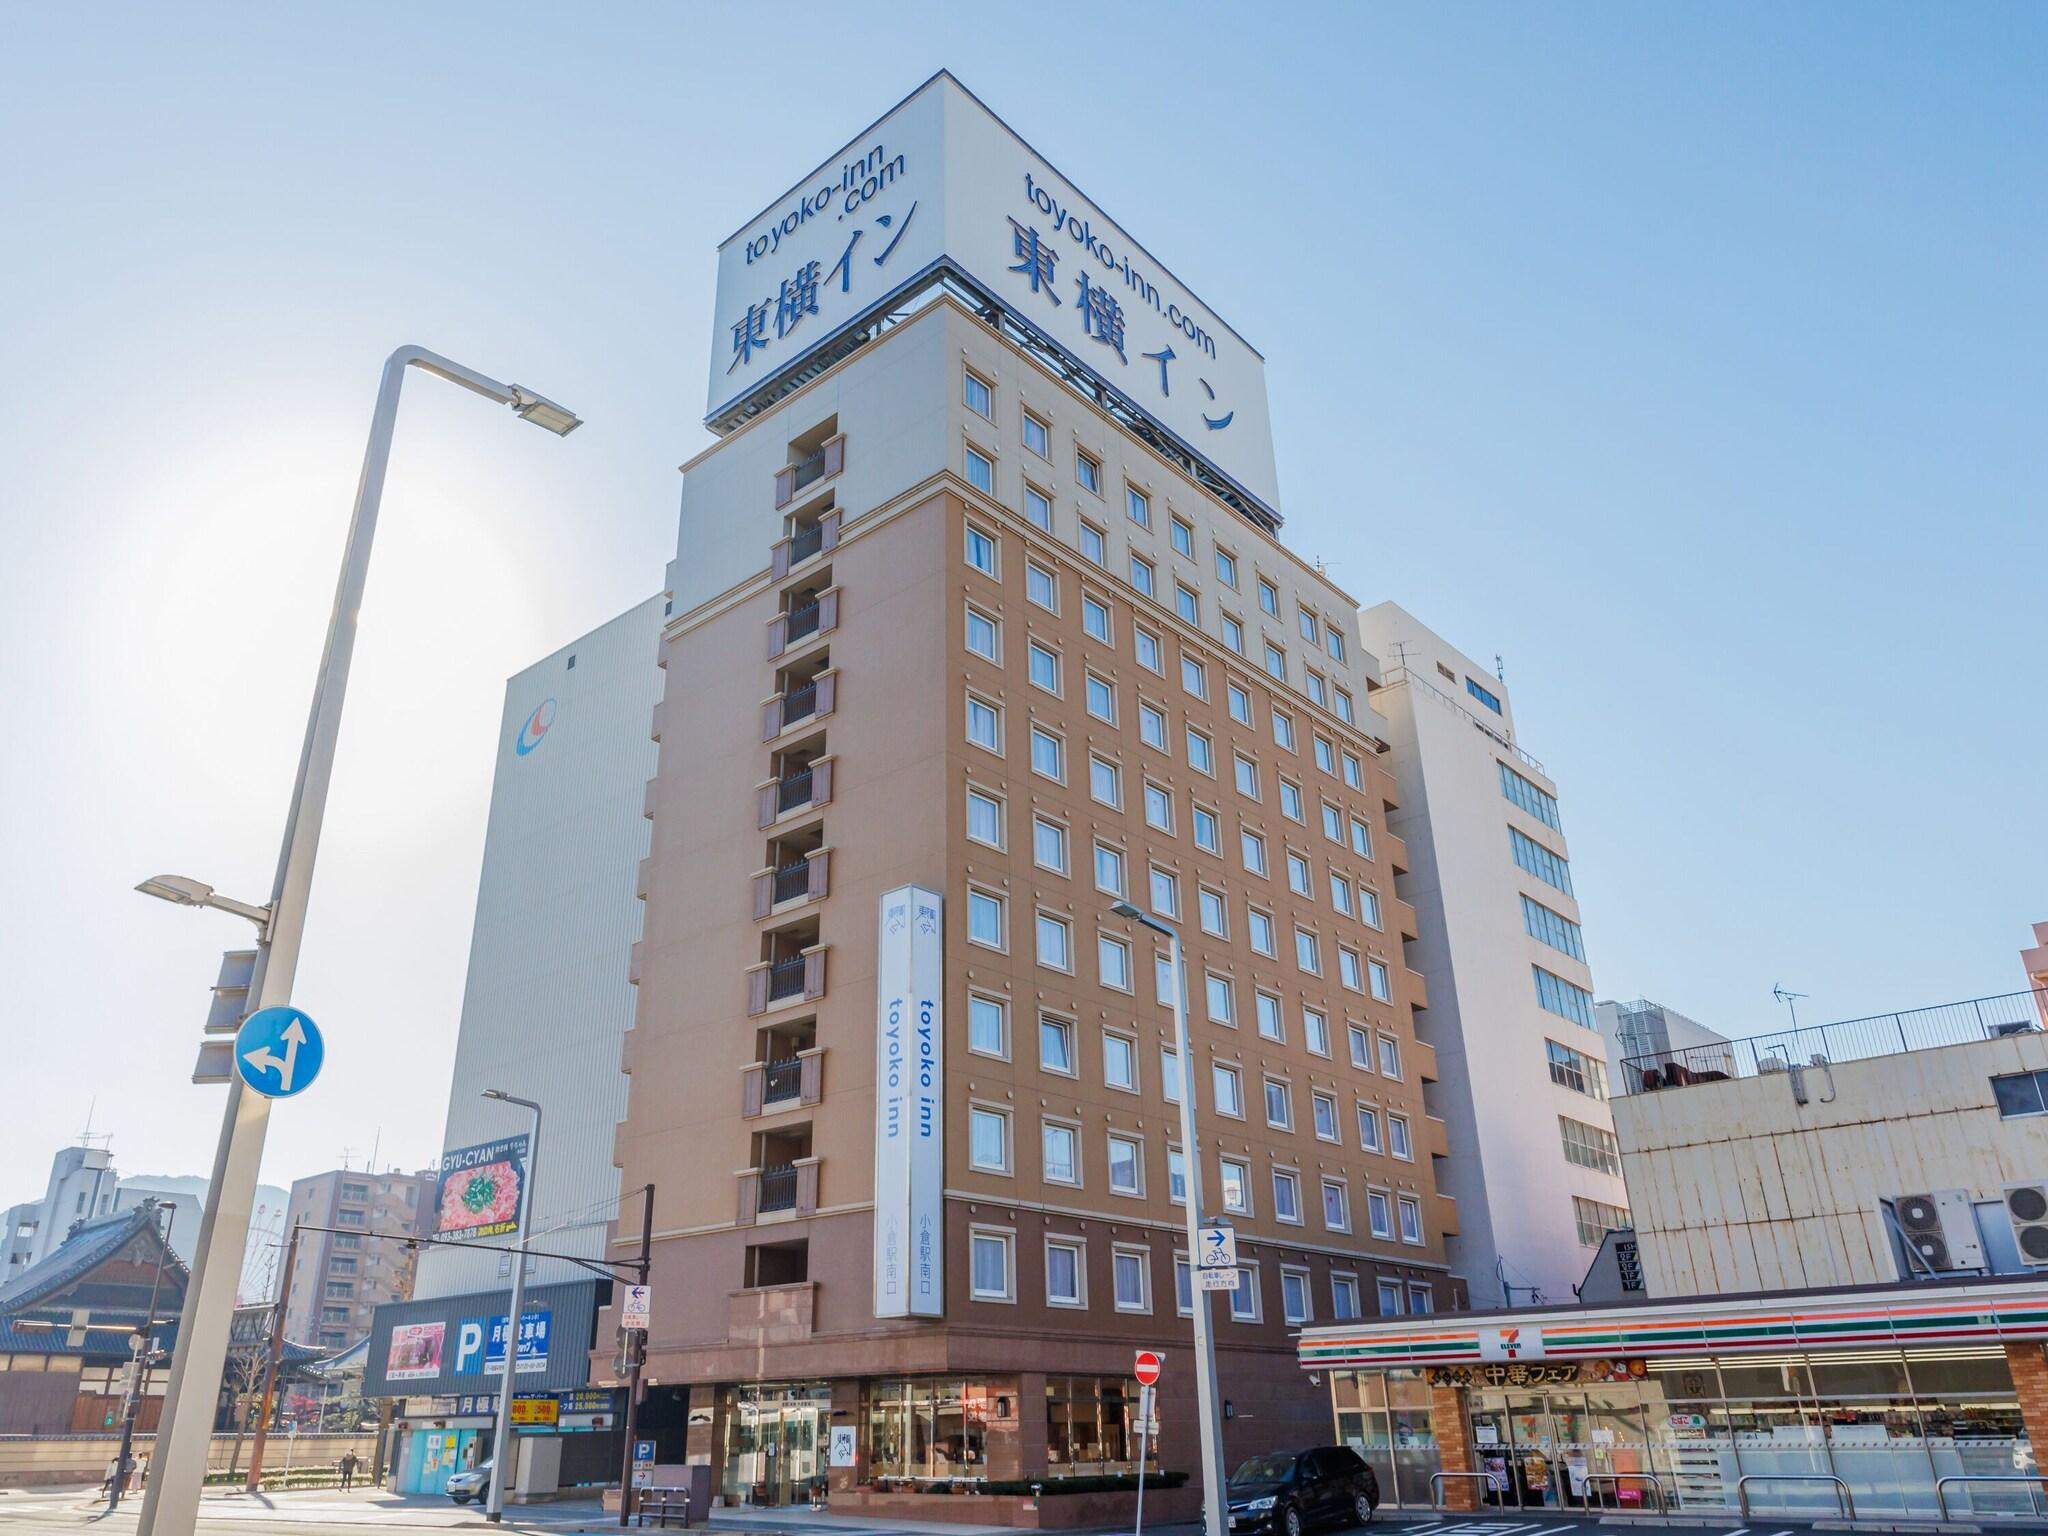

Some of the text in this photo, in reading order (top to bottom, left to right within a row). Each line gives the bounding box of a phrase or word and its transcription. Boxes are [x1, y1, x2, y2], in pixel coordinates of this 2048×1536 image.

[746, 144, 883, 264] toyoko-inn
[838, 154, 905, 221] .com
[726, 200, 917, 375] 東横イン
[1025, 172, 1216, 360] toyoko-inn.com
[1006, 215, 1234, 430] 東横イン
[886, 998, 903, 1138] toyoko inn
[917, 999, 934, 1138] toyoko inn
[442, 1145, 494, 1171] GYU-CYAN
[886, 1215, 898, 1296] 小倉駅南口
[920, 1213, 932, 1296] 小倉駅南口
[457, 1323, 482, 1371] P
[1484, 1363, 1577, 1386] 中華フェア
[638, 1443, 651, 1458] P
